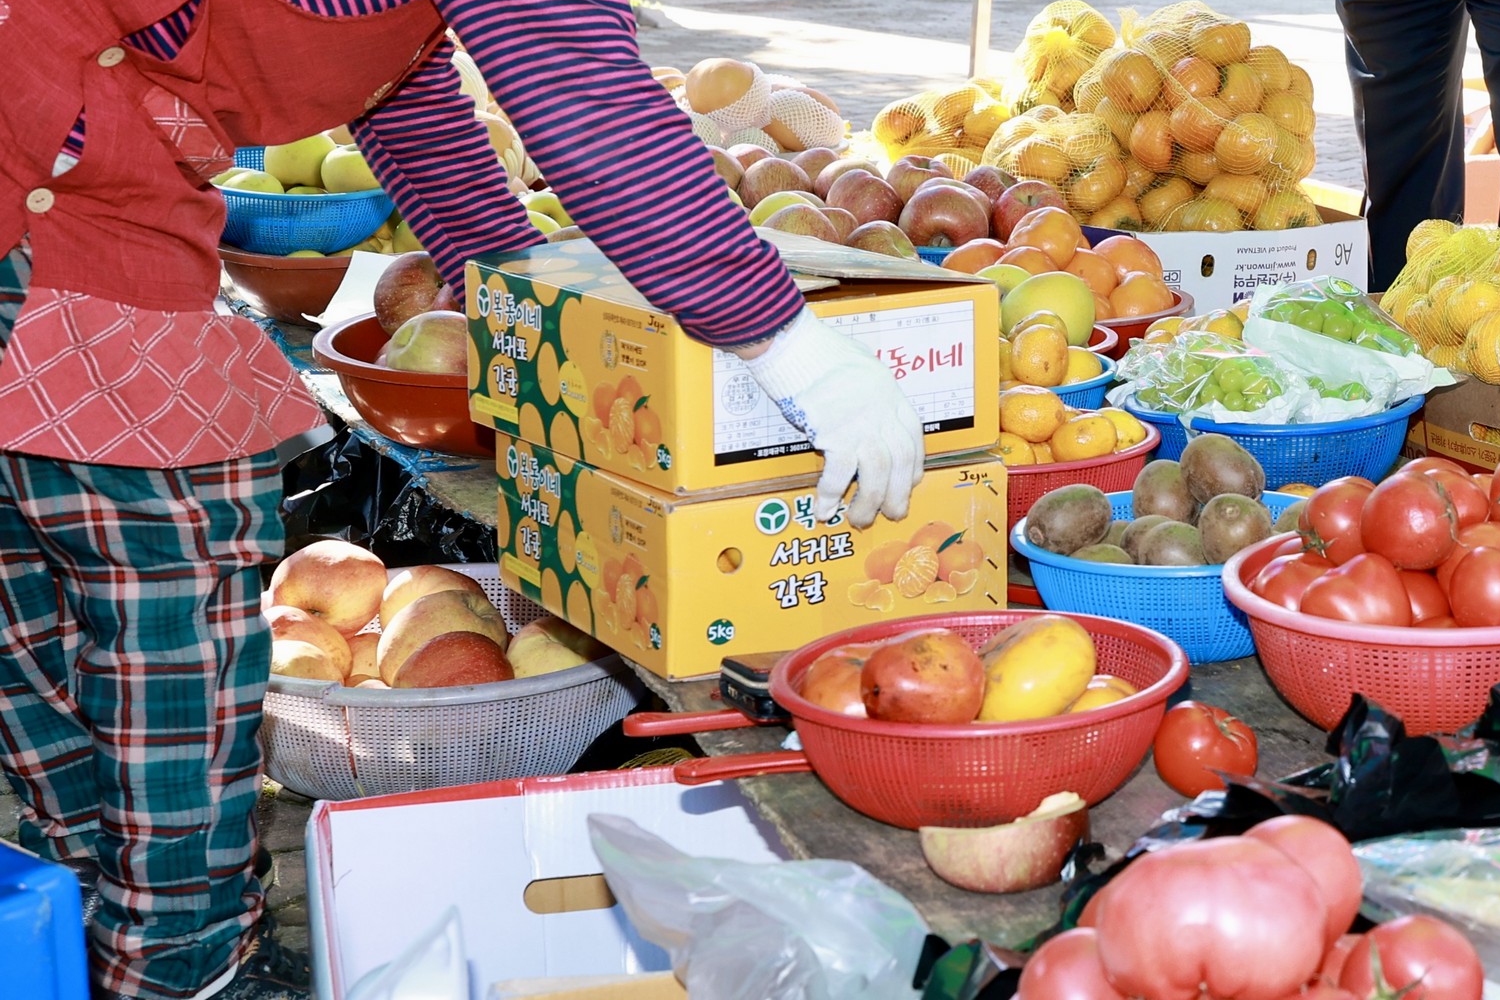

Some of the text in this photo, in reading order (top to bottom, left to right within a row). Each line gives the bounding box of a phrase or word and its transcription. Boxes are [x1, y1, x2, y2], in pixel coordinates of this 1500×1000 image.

[1268, 246, 1275, 254] of
[1277, 245, 1297, 253] Product
[1334, 242, 1353, 266] A6
[1235, 261, 1297, 272] www.jinwon.kr
[492, 289, 542, 333] 복동이네
[492, 329, 528, 361] 서귀포
[874, 342, 963, 380] 동이네
[492, 362, 518, 397] 감귤
[519, 451, 561, 499] 복동이네
[656, 448, 672, 469] 5kg
[959, 469, 988, 484] Jeju
[520, 493, 550, 526] 서귀포
[520, 526, 542, 560] 감귤
[769, 531, 854, 567] 서귀포
[769, 571, 827, 610] 감귤
[707, 622, 735, 641] 5kg
